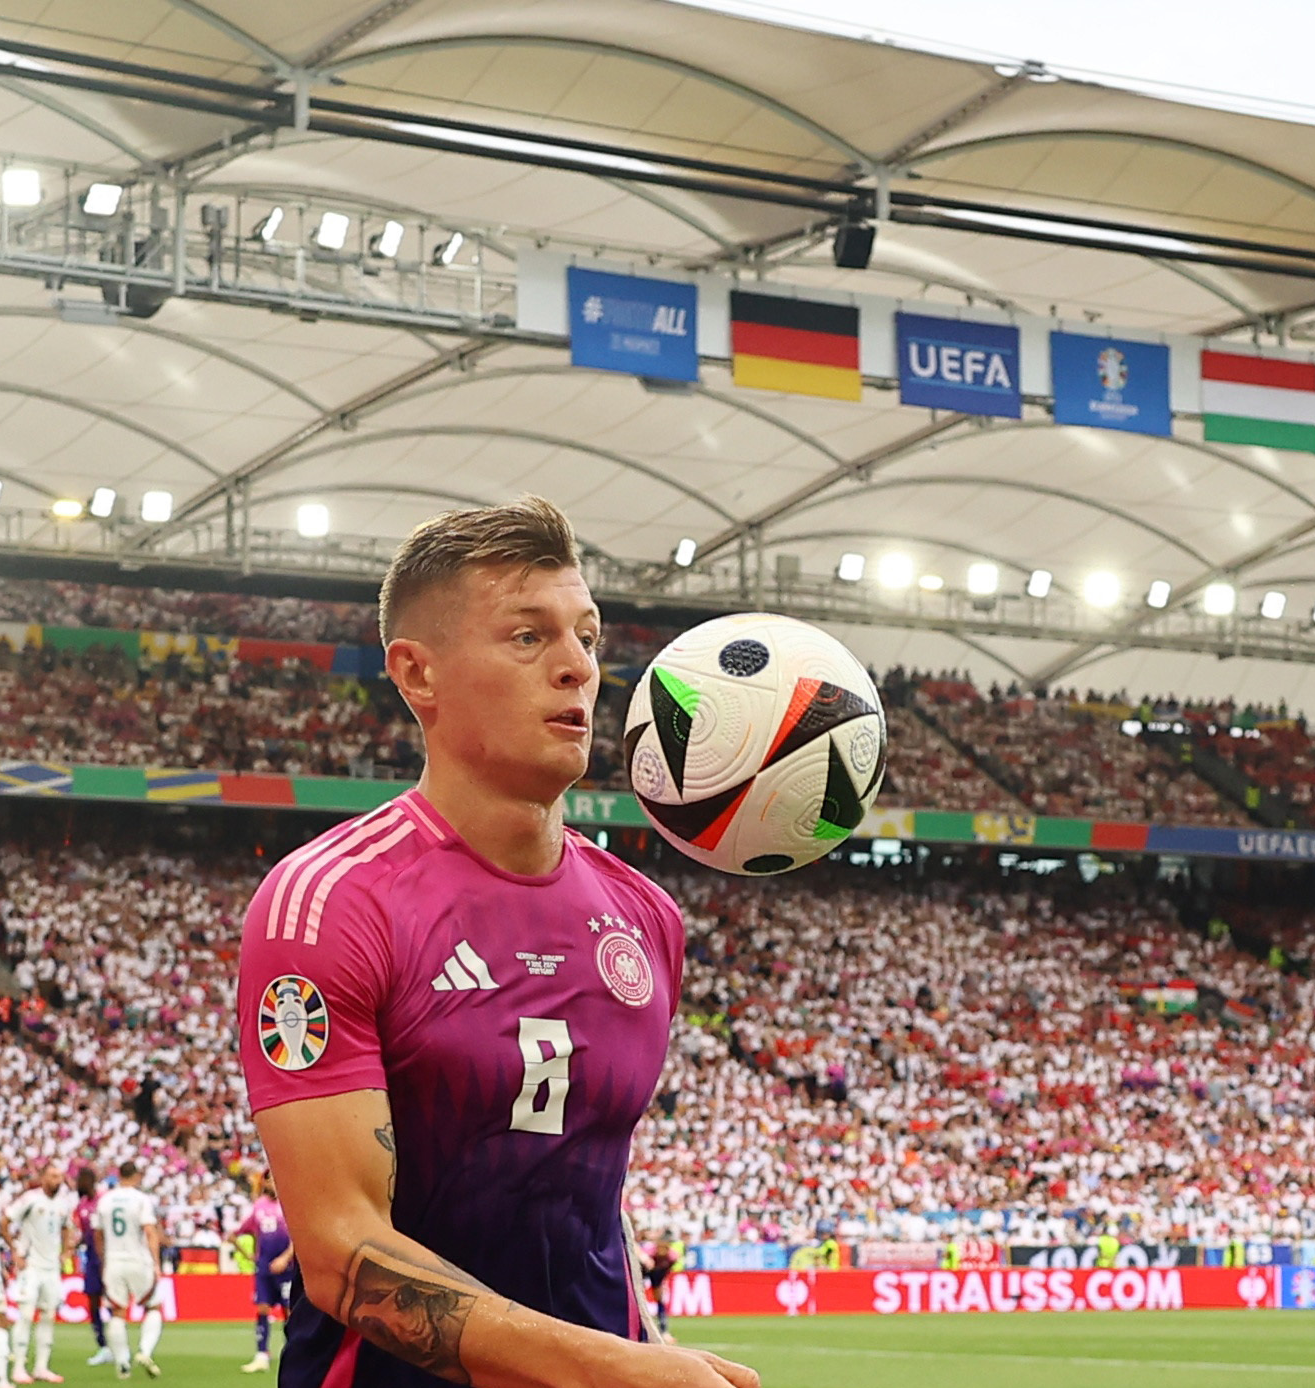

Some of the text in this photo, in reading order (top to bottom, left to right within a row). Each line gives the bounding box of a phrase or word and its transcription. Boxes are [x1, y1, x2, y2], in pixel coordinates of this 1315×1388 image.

[909, 343, 1011, 388] UEFA
[509, 1017, 573, 1135] 8
[112, 1207, 127, 1237] 6
[873, 1271, 1183, 1313] STRAUSS.COM
